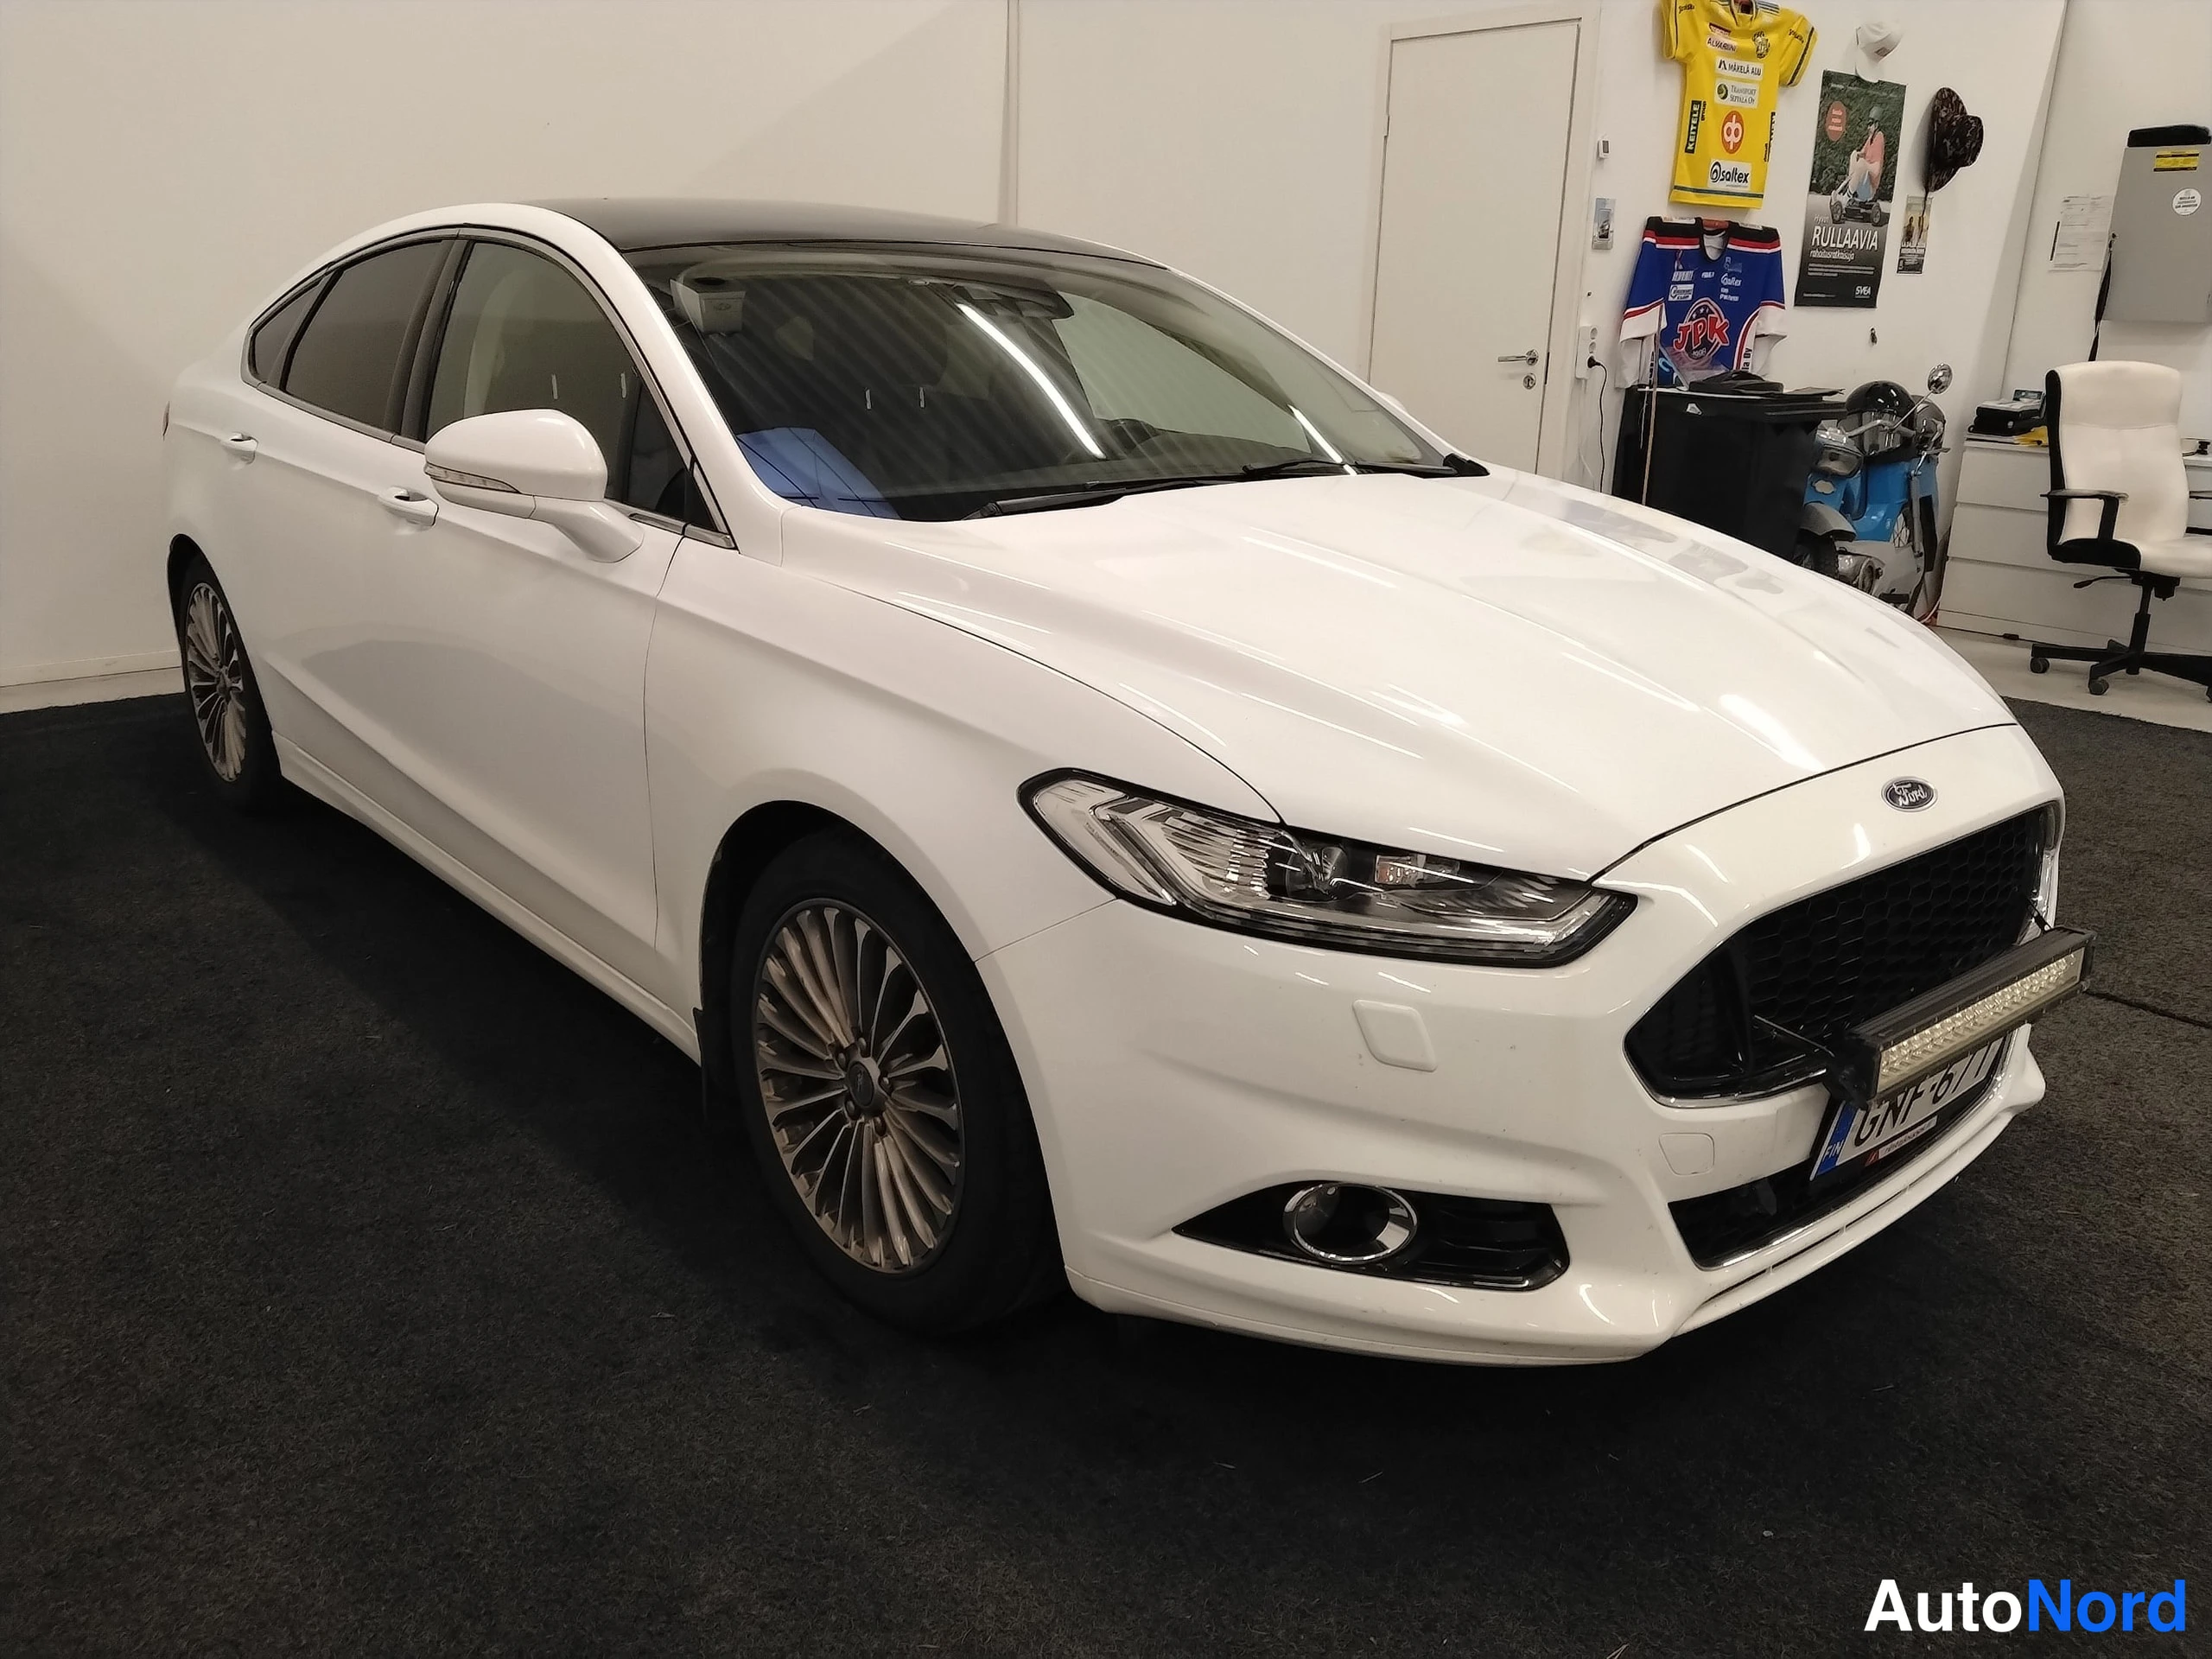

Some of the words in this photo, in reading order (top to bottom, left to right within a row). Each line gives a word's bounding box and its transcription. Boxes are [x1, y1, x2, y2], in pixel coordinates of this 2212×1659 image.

[1728, 61, 1750, 74] MÄKELÄ
[1751, 67, 1762, 76] ALU
[1687, 103, 1700, 150] KEITELE
[1811, 226, 1878, 251] RULLAAVIA
[1855, 285, 1872, 296] SVEA
[1673, 314, 1730, 351] JPK
[1892, 783, 1928, 806] Ford
[1822, 1139, 1845, 1162] FIN
